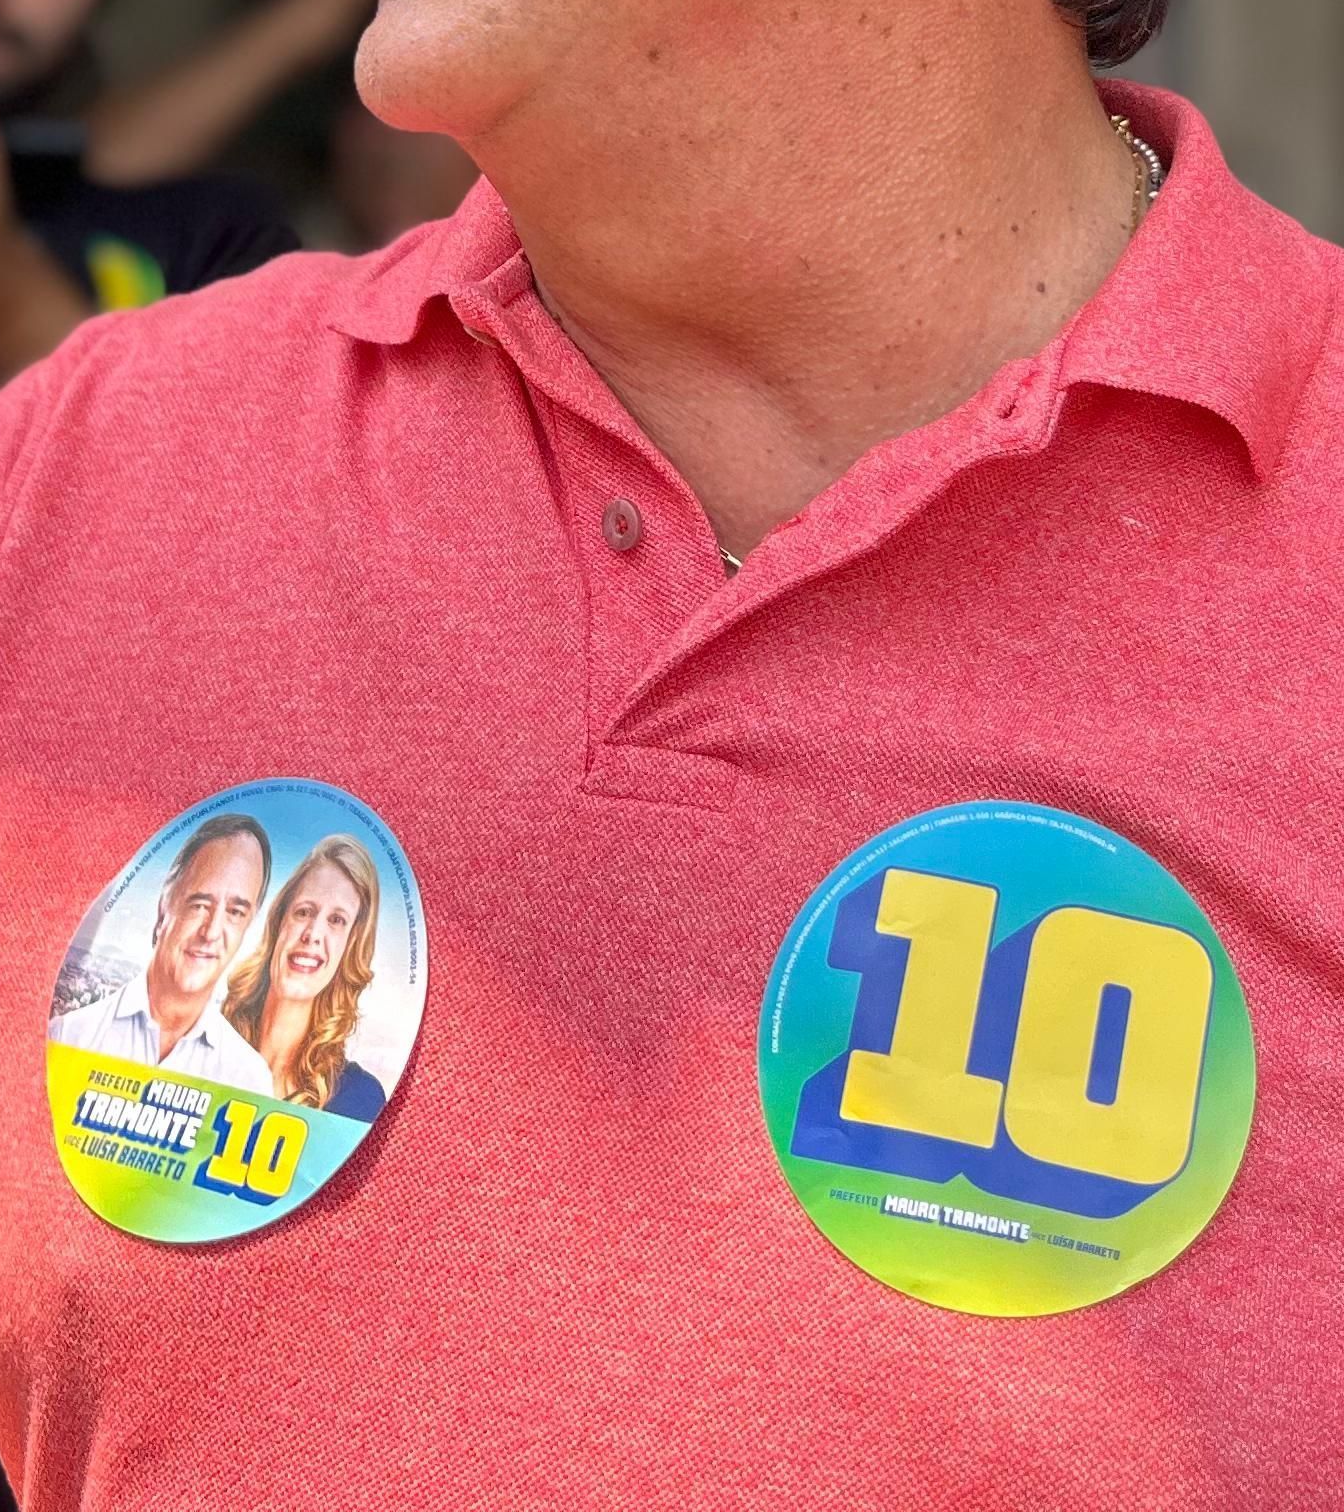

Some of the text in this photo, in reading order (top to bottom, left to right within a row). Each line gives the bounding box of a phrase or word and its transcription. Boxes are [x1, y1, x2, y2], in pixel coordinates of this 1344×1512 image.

[839, 868, 1213, 1184] 10
[79, 1089, 203, 1148] TRAMONTE
[88, 1070, 212, 1116] PREFEITO MAURO
[80, 1132, 116, 1159] LUÍSA
[117, 1145, 186, 1182] BARRETO
[206, 1099, 308, 1197] 10
[829, 1188, 878, 1207] PREFEITO
[884, 1194, 940, 1221] MAURO
[942, 1206, 1030, 1241] TRAMONTE
[1075, 1240, 1120, 1261] BARRETO
